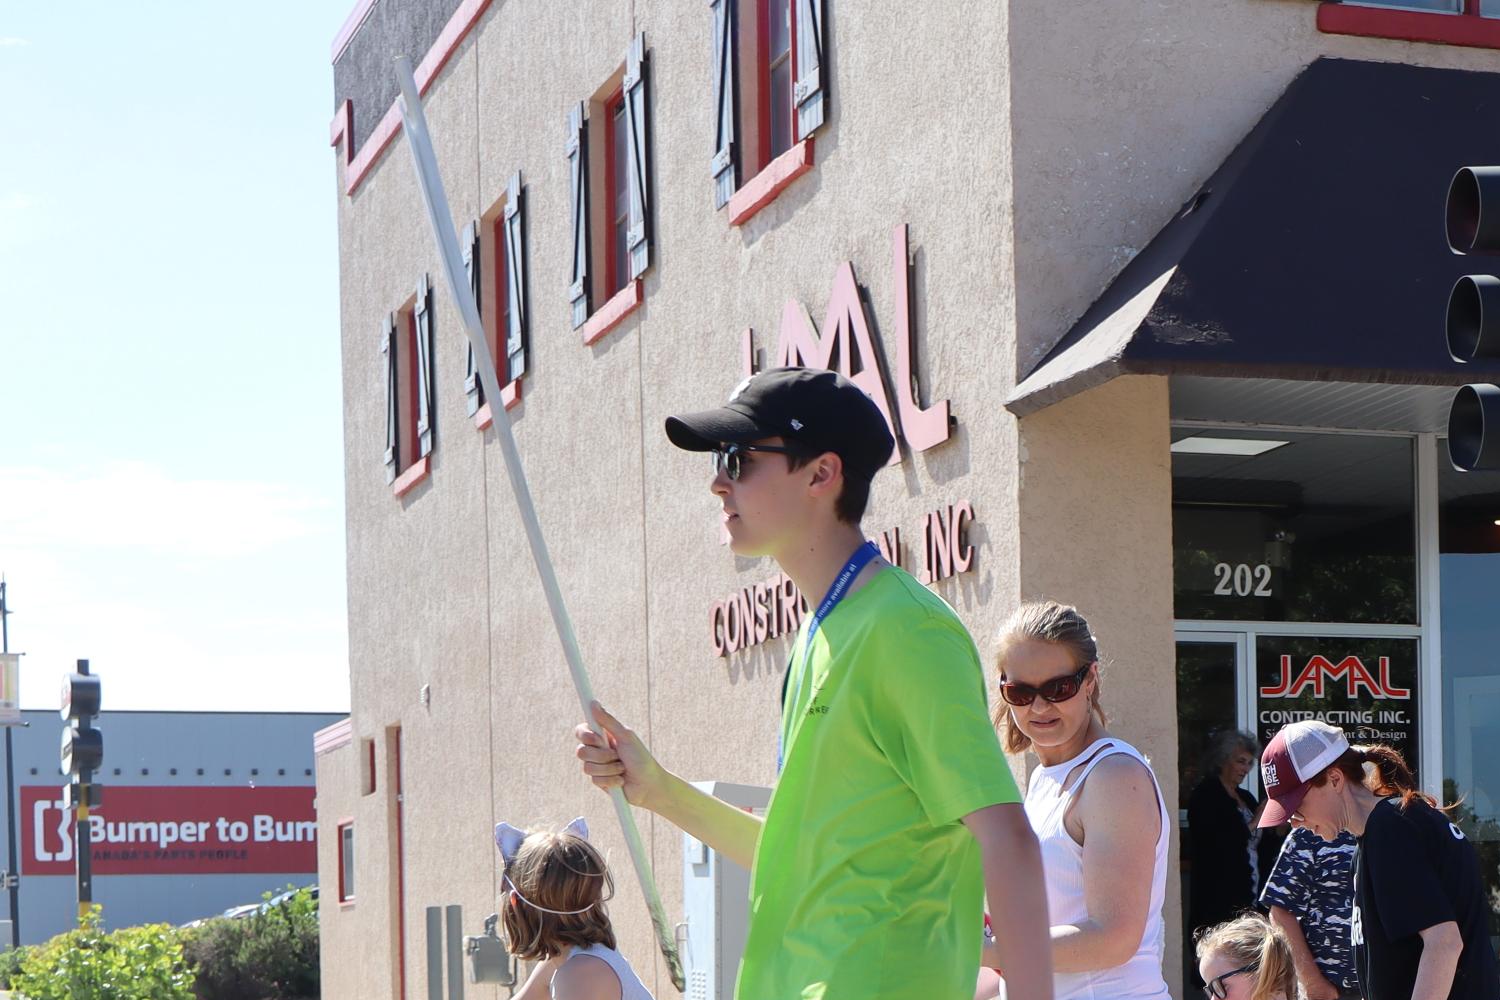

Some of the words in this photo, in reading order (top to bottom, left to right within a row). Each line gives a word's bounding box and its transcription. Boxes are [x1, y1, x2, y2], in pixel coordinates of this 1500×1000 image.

[919, 499, 976, 585] INC
[1214, 562, 1273, 597] 202
[1259, 654, 1411, 700] JAMAL
[1259, 710, 1374, 725] CONTRACTING
[1378, 710, 1411, 725] INC.
[1358, 728, 1368, 739] &
[1371, 727, 1407, 741] Design
[88, 814, 210, 849] Bumper
[216, 816, 249, 842] to
